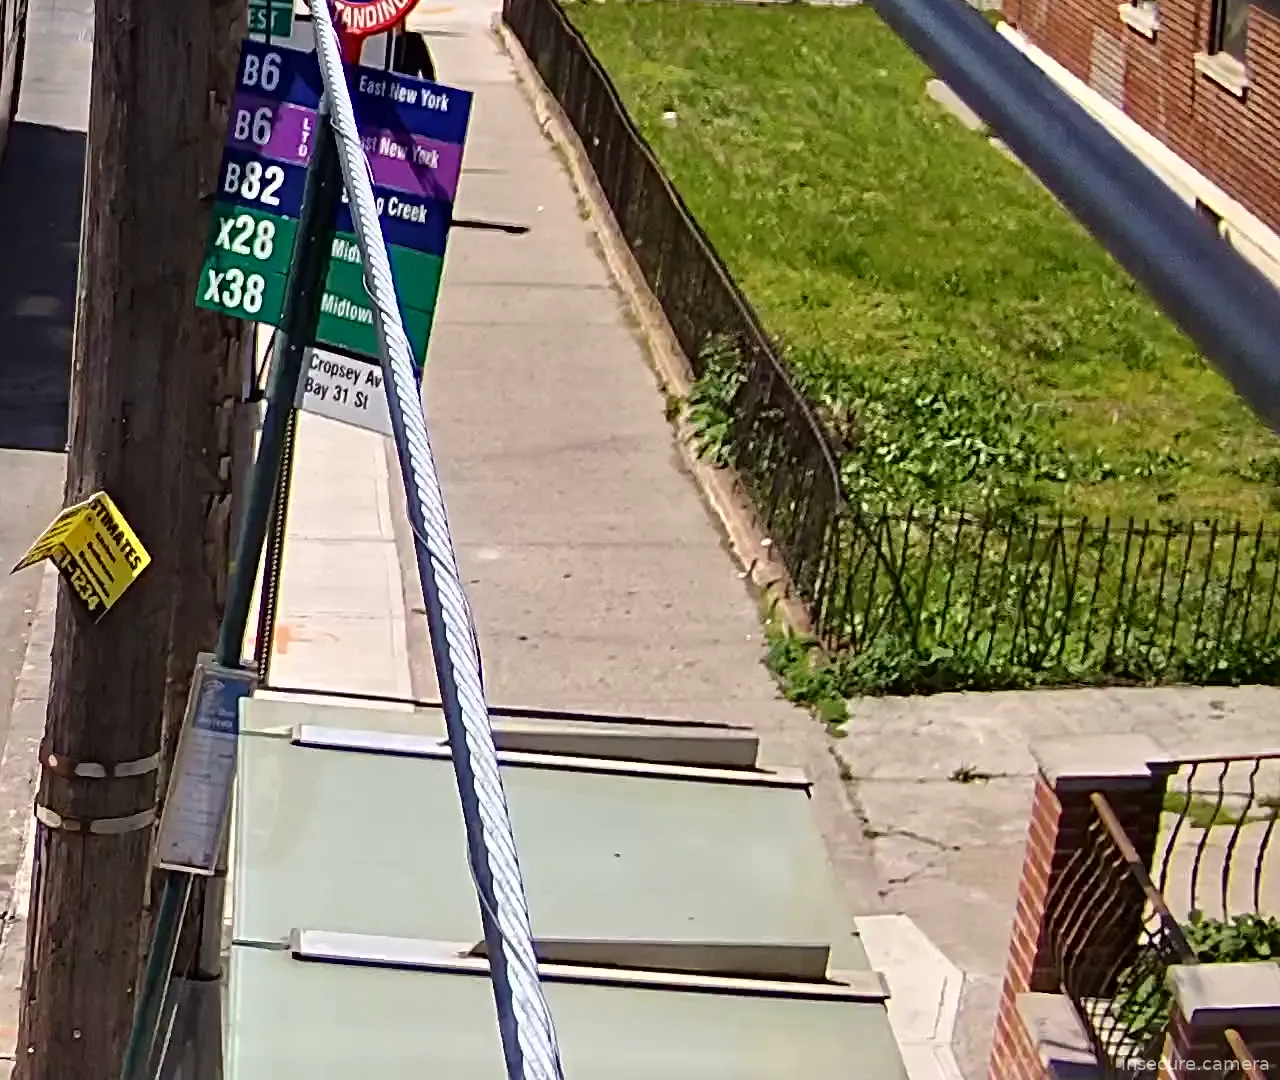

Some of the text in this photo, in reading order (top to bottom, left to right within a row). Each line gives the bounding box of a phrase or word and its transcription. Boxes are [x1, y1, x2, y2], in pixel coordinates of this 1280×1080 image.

[242, 52, 282, 92] B6
[359, 74, 449, 113] East New York
[234, 107, 273, 145] B6
[379, 137, 408, 161] New
[412, 144, 440, 169] York
[224, 160, 285, 207] B82
[388, 196, 428, 224] Creek
[331, 237, 363, 265] Midt
[310, 352, 361, 385] Cropsey
[304, 377, 369, 410] Bay 31 St
[89, 498, 143, 571] STIMATES
